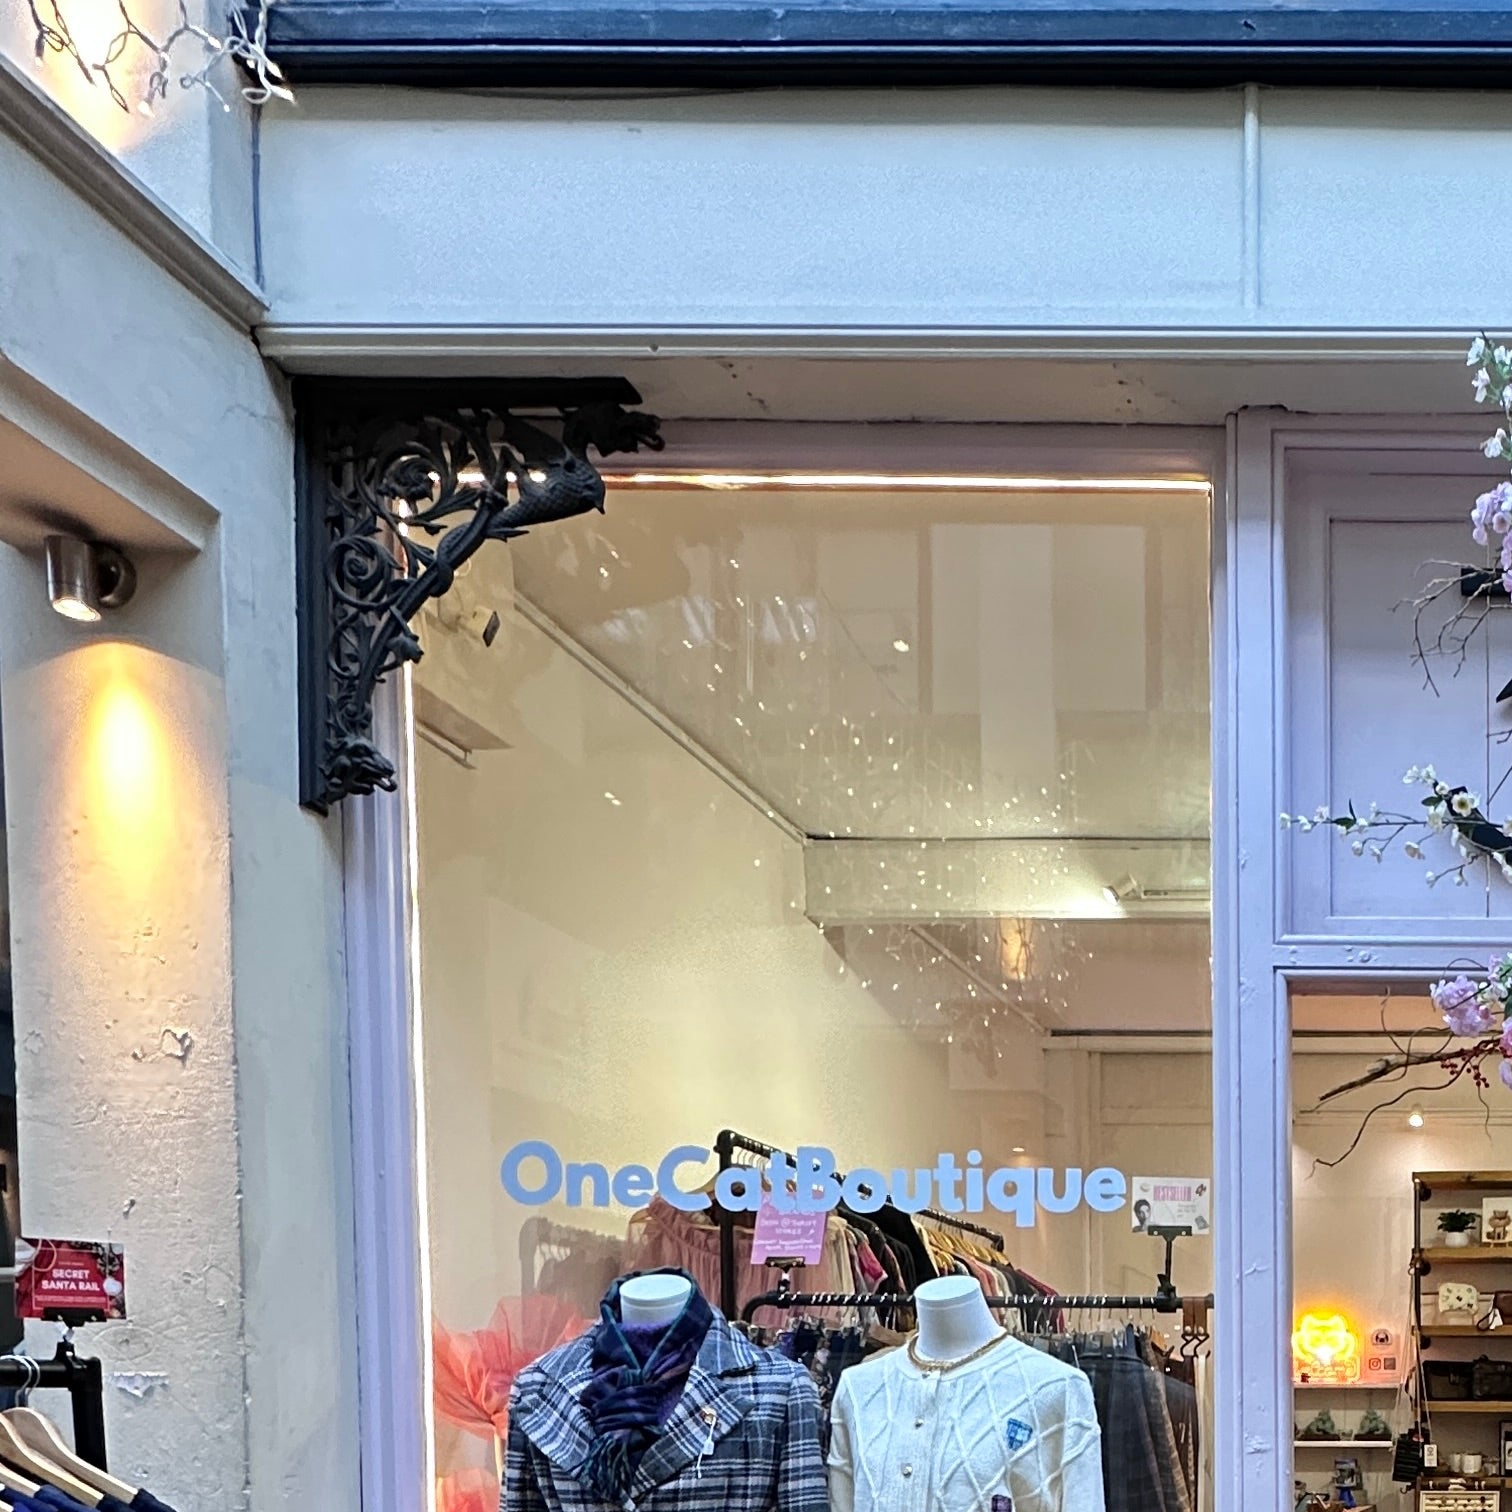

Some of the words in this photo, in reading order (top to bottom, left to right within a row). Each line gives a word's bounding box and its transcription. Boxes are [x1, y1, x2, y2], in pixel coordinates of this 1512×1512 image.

[500, 1139, 1127, 1228] OneCatBoutique
[52, 1268, 91, 1279] SECRET
[41, 1280, 77, 1290] SANTA
[79, 1281, 101, 1291] RAIL
